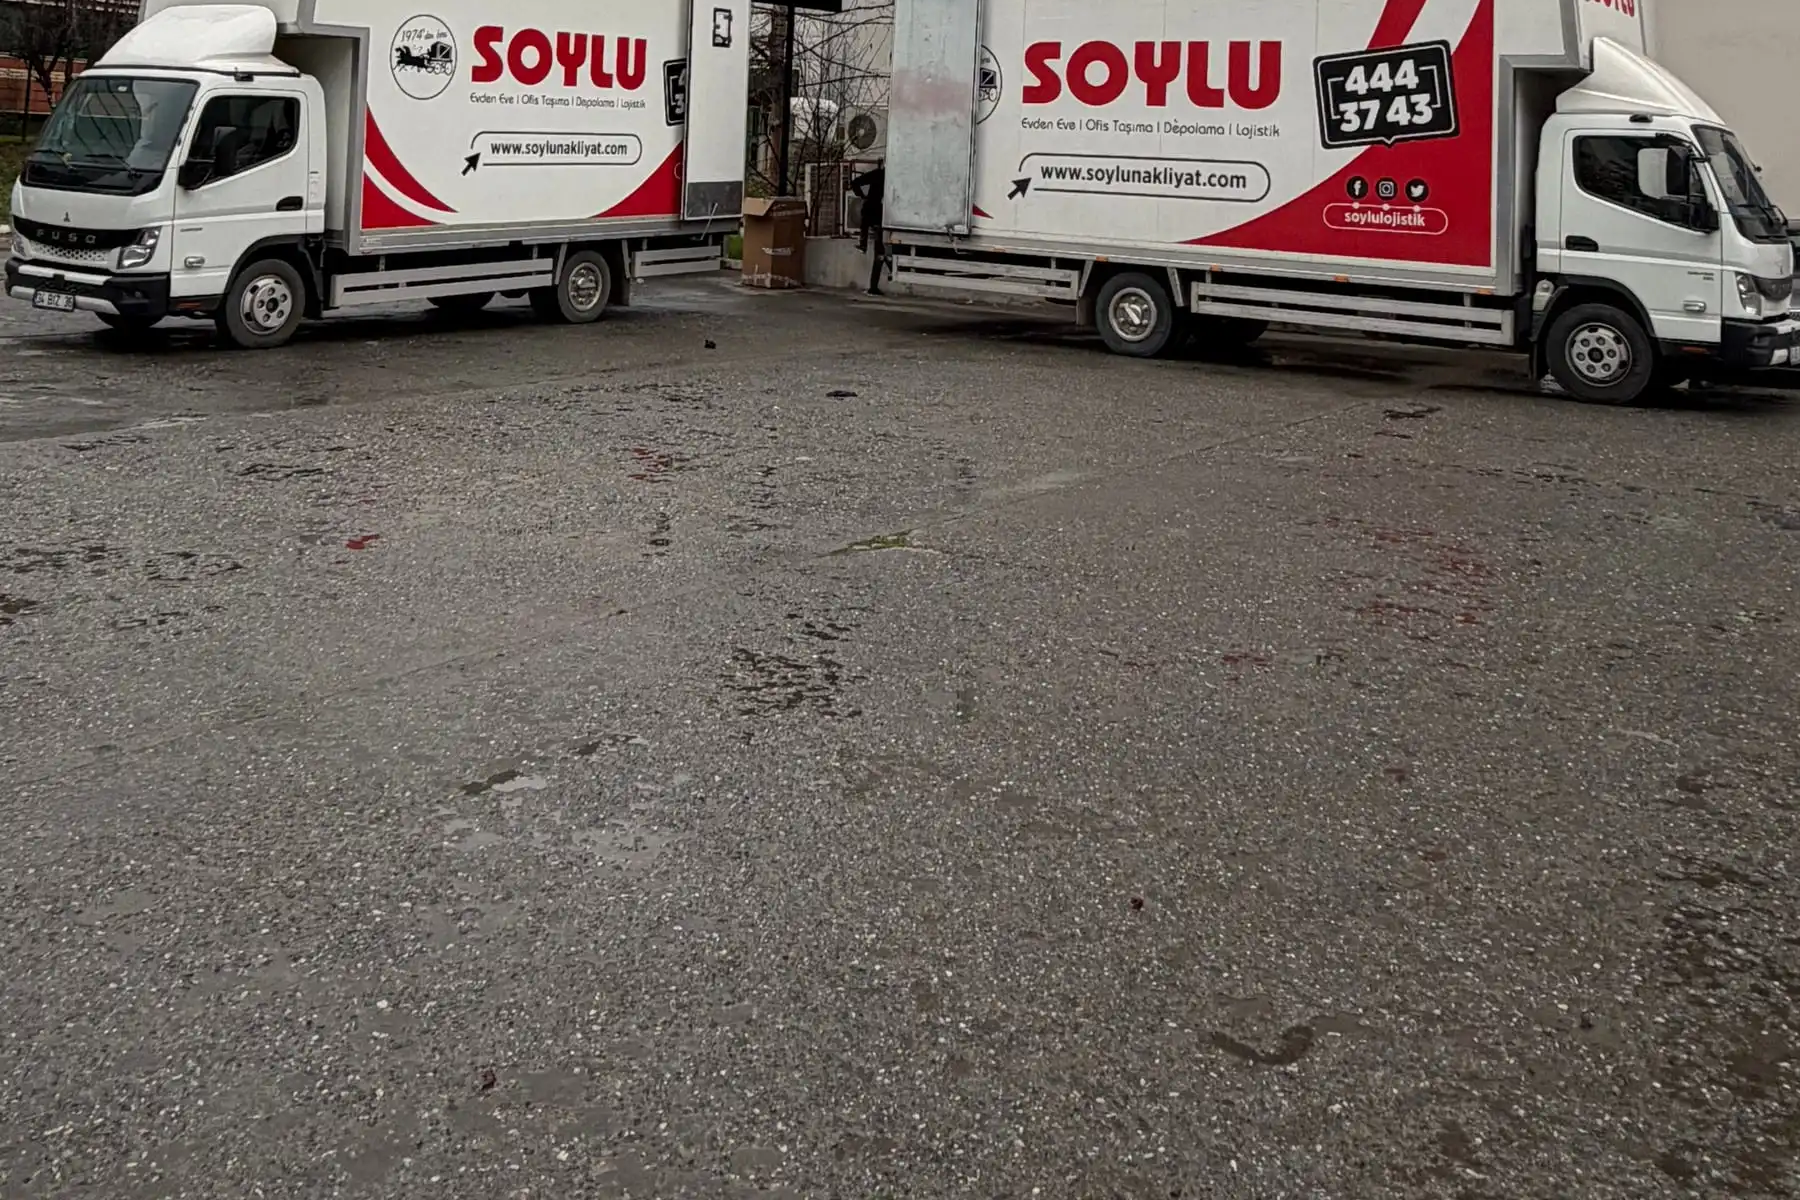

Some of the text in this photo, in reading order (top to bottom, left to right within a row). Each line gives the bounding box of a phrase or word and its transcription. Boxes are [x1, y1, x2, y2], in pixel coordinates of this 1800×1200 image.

[471, 25, 647, 90] SOYLU
[1022, 40, 1282, 109] SOYLU
[1345, 59, 1419, 95] 444
[470, 92, 497, 104] Evden
[499, 93, 514, 105] Eve
[521, 94, 539, 106] Ofis
[1339, 93, 1433, 132] 37 43
[1021, 117, 1054, 130] Evden
[1056, 118, 1076, 130] Eve
[1085, 118, 1109, 131] Ofis
[1112, 119, 1154, 135] Taşıma
[1236, 123, 1280, 140] Lojistik
[490, 140, 628, 158] www.soylunakliyat.com
[1041, 165, 1247, 189] www.soylunakliyat.com
[1344, 211, 1425, 227] soylulojistik
[36, 229, 96, 244] FUSO
